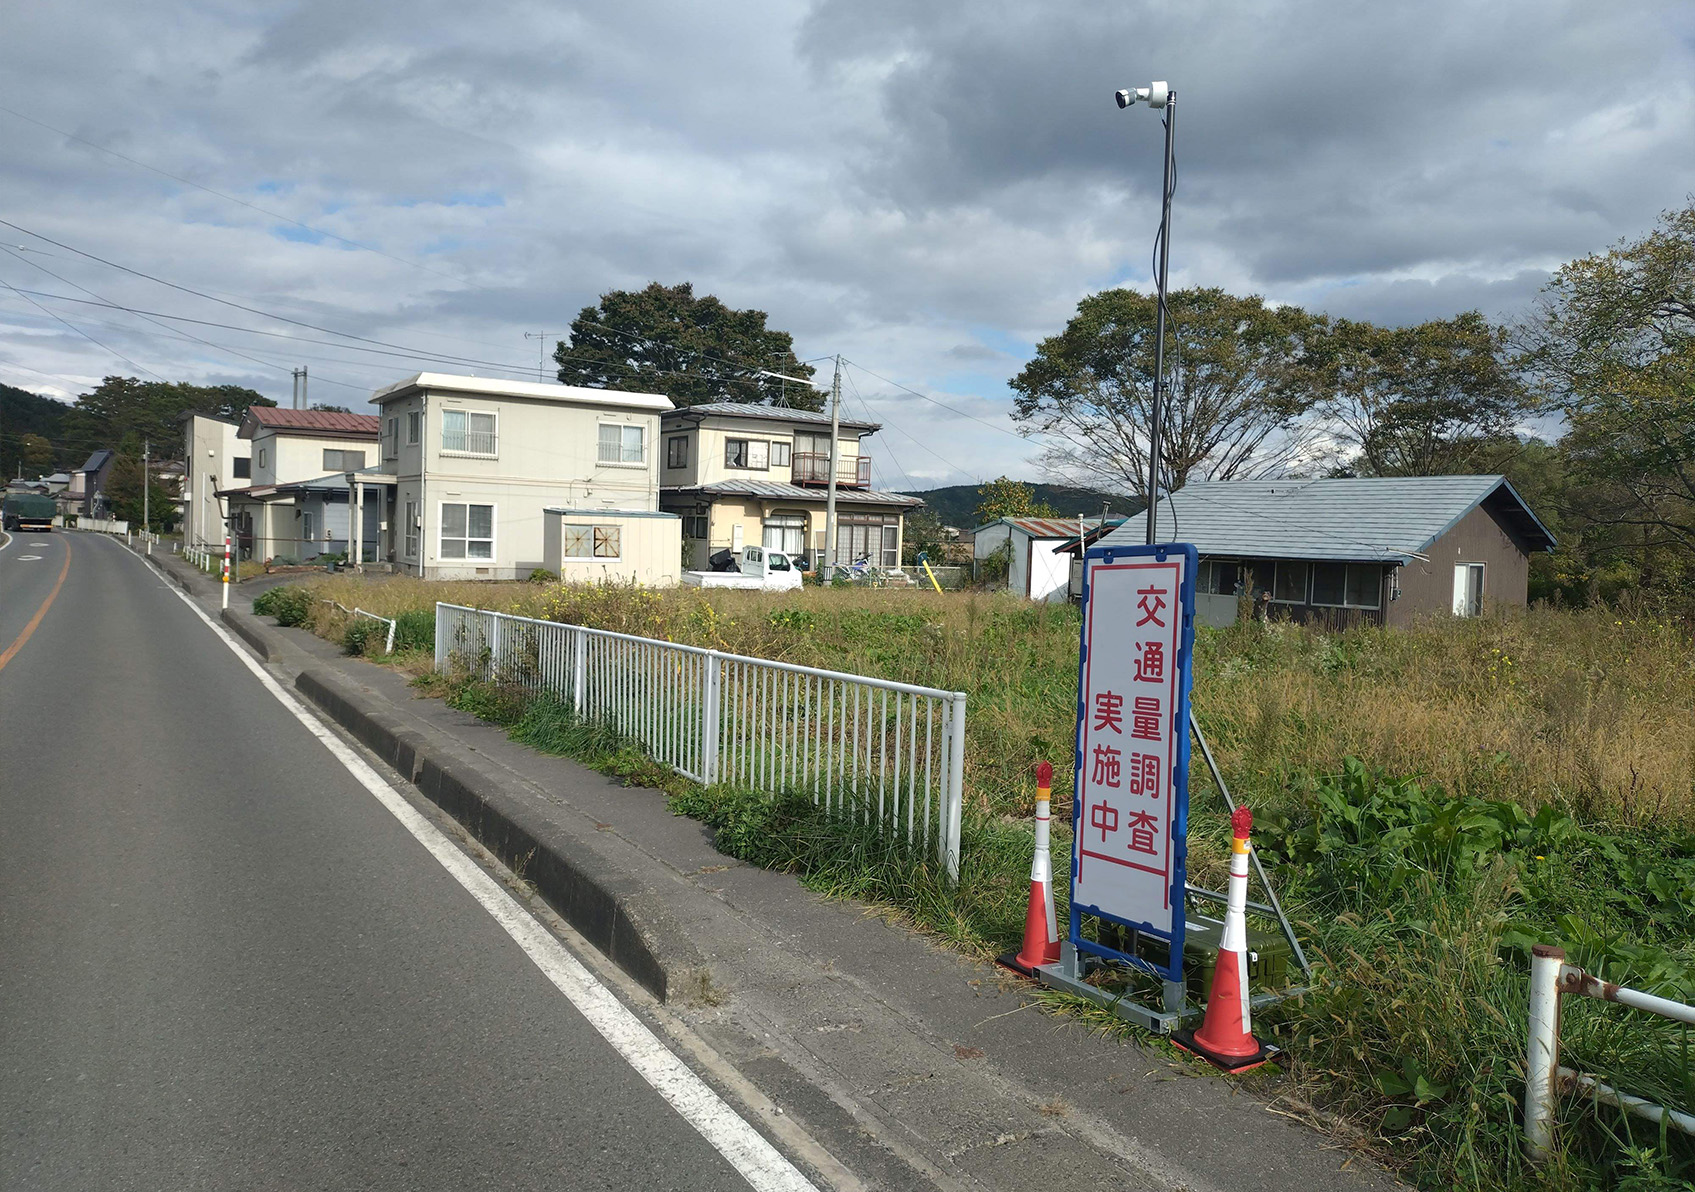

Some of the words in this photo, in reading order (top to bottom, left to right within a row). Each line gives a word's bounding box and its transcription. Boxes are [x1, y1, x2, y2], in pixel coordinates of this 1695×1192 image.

[1092, 691, 1123, 842] 実施中
[1128, 585, 1167, 855] 交通量調査
